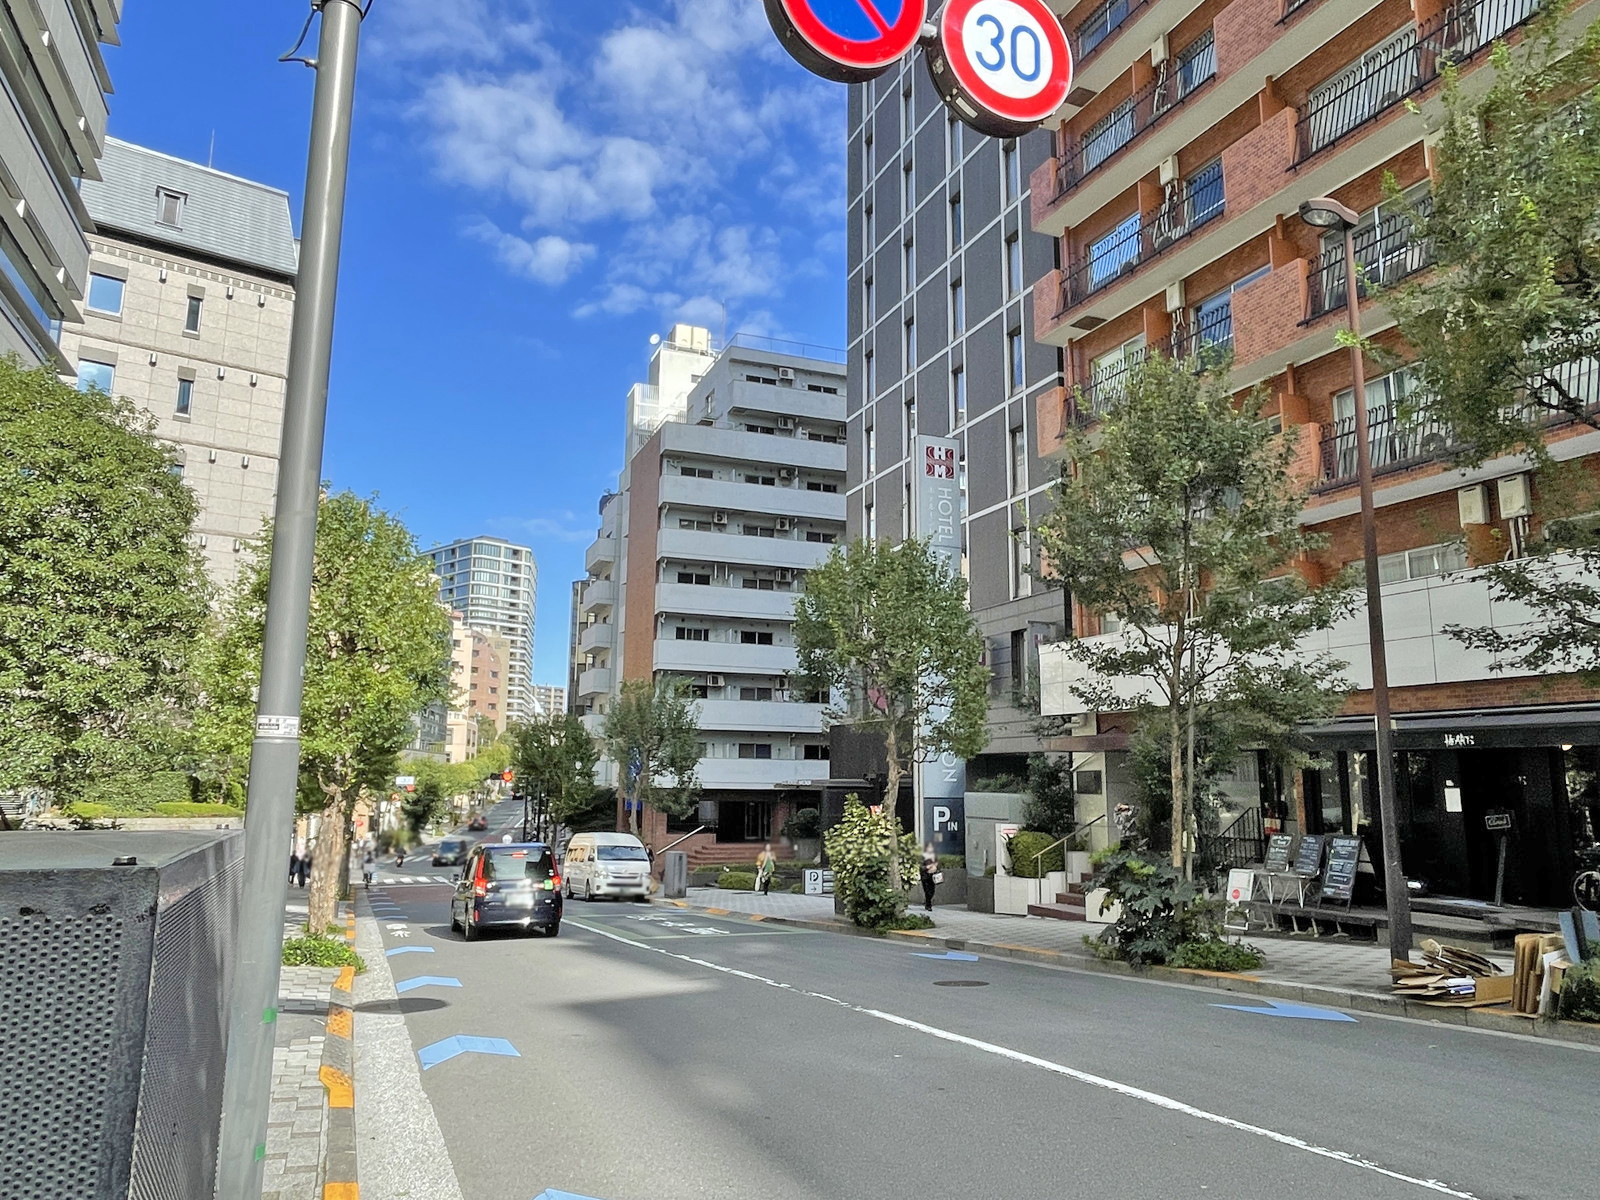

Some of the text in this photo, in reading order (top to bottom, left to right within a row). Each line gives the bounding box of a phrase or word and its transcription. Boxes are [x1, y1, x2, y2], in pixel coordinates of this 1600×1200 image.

[975, 14, 1041, 82] 30
[937, 487, 953, 543] HOTEL
[809, 871, 819, 882] P
